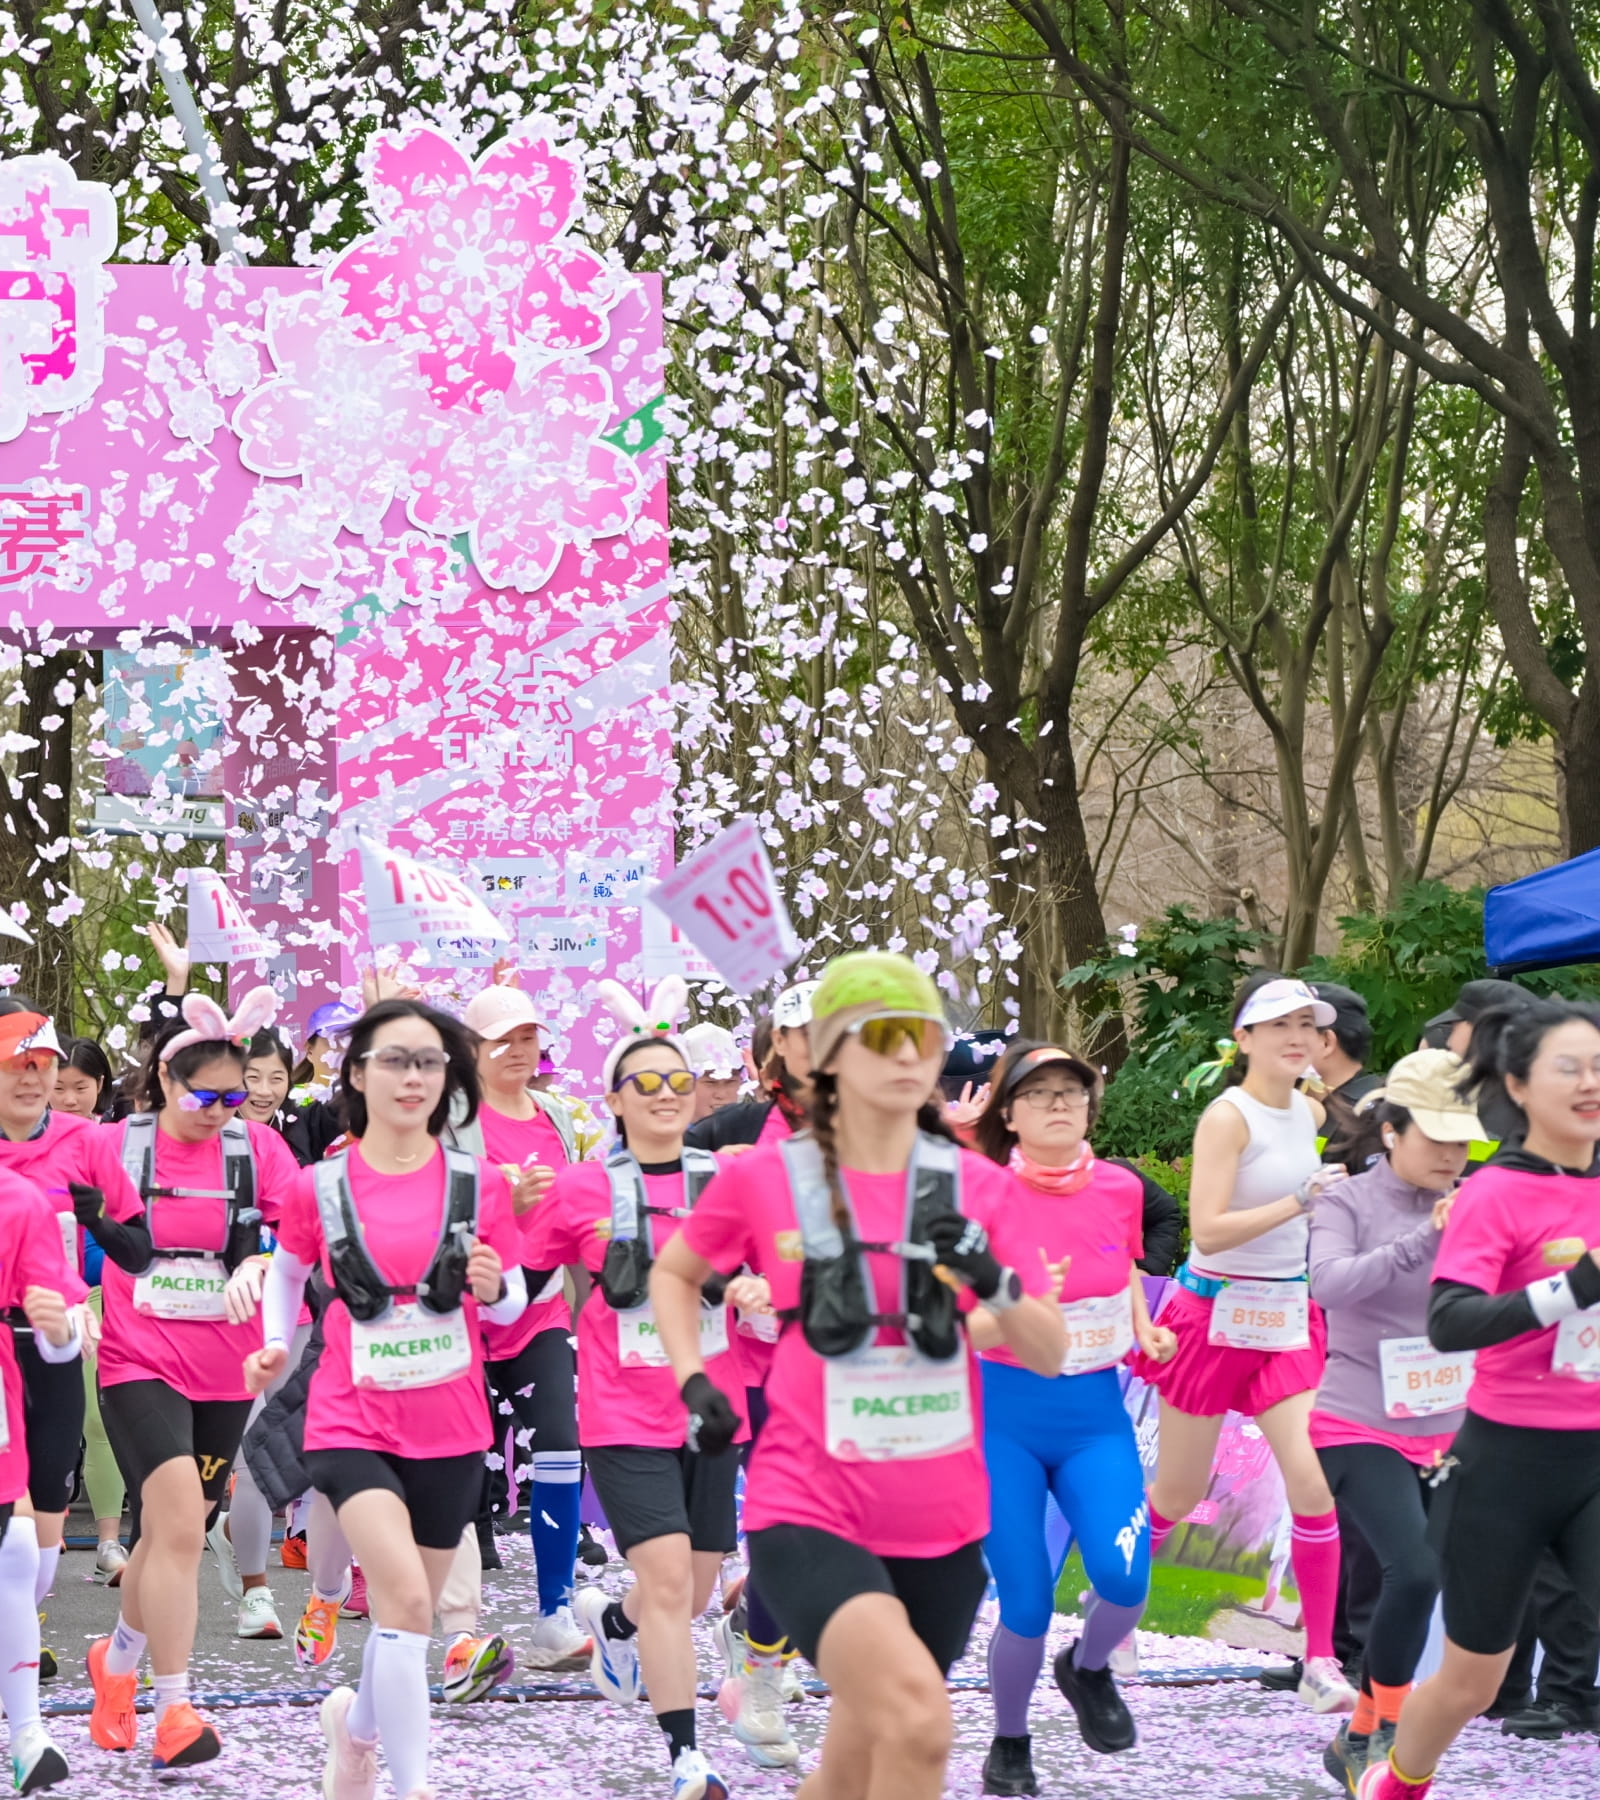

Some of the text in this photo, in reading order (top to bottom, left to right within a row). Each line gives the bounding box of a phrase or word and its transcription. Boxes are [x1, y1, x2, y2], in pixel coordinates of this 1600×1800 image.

[151, 1274, 226, 1293] PACER12
[369, 1334, 452, 1359] PACER10
[1407, 1364, 1462, 1390] B1491
